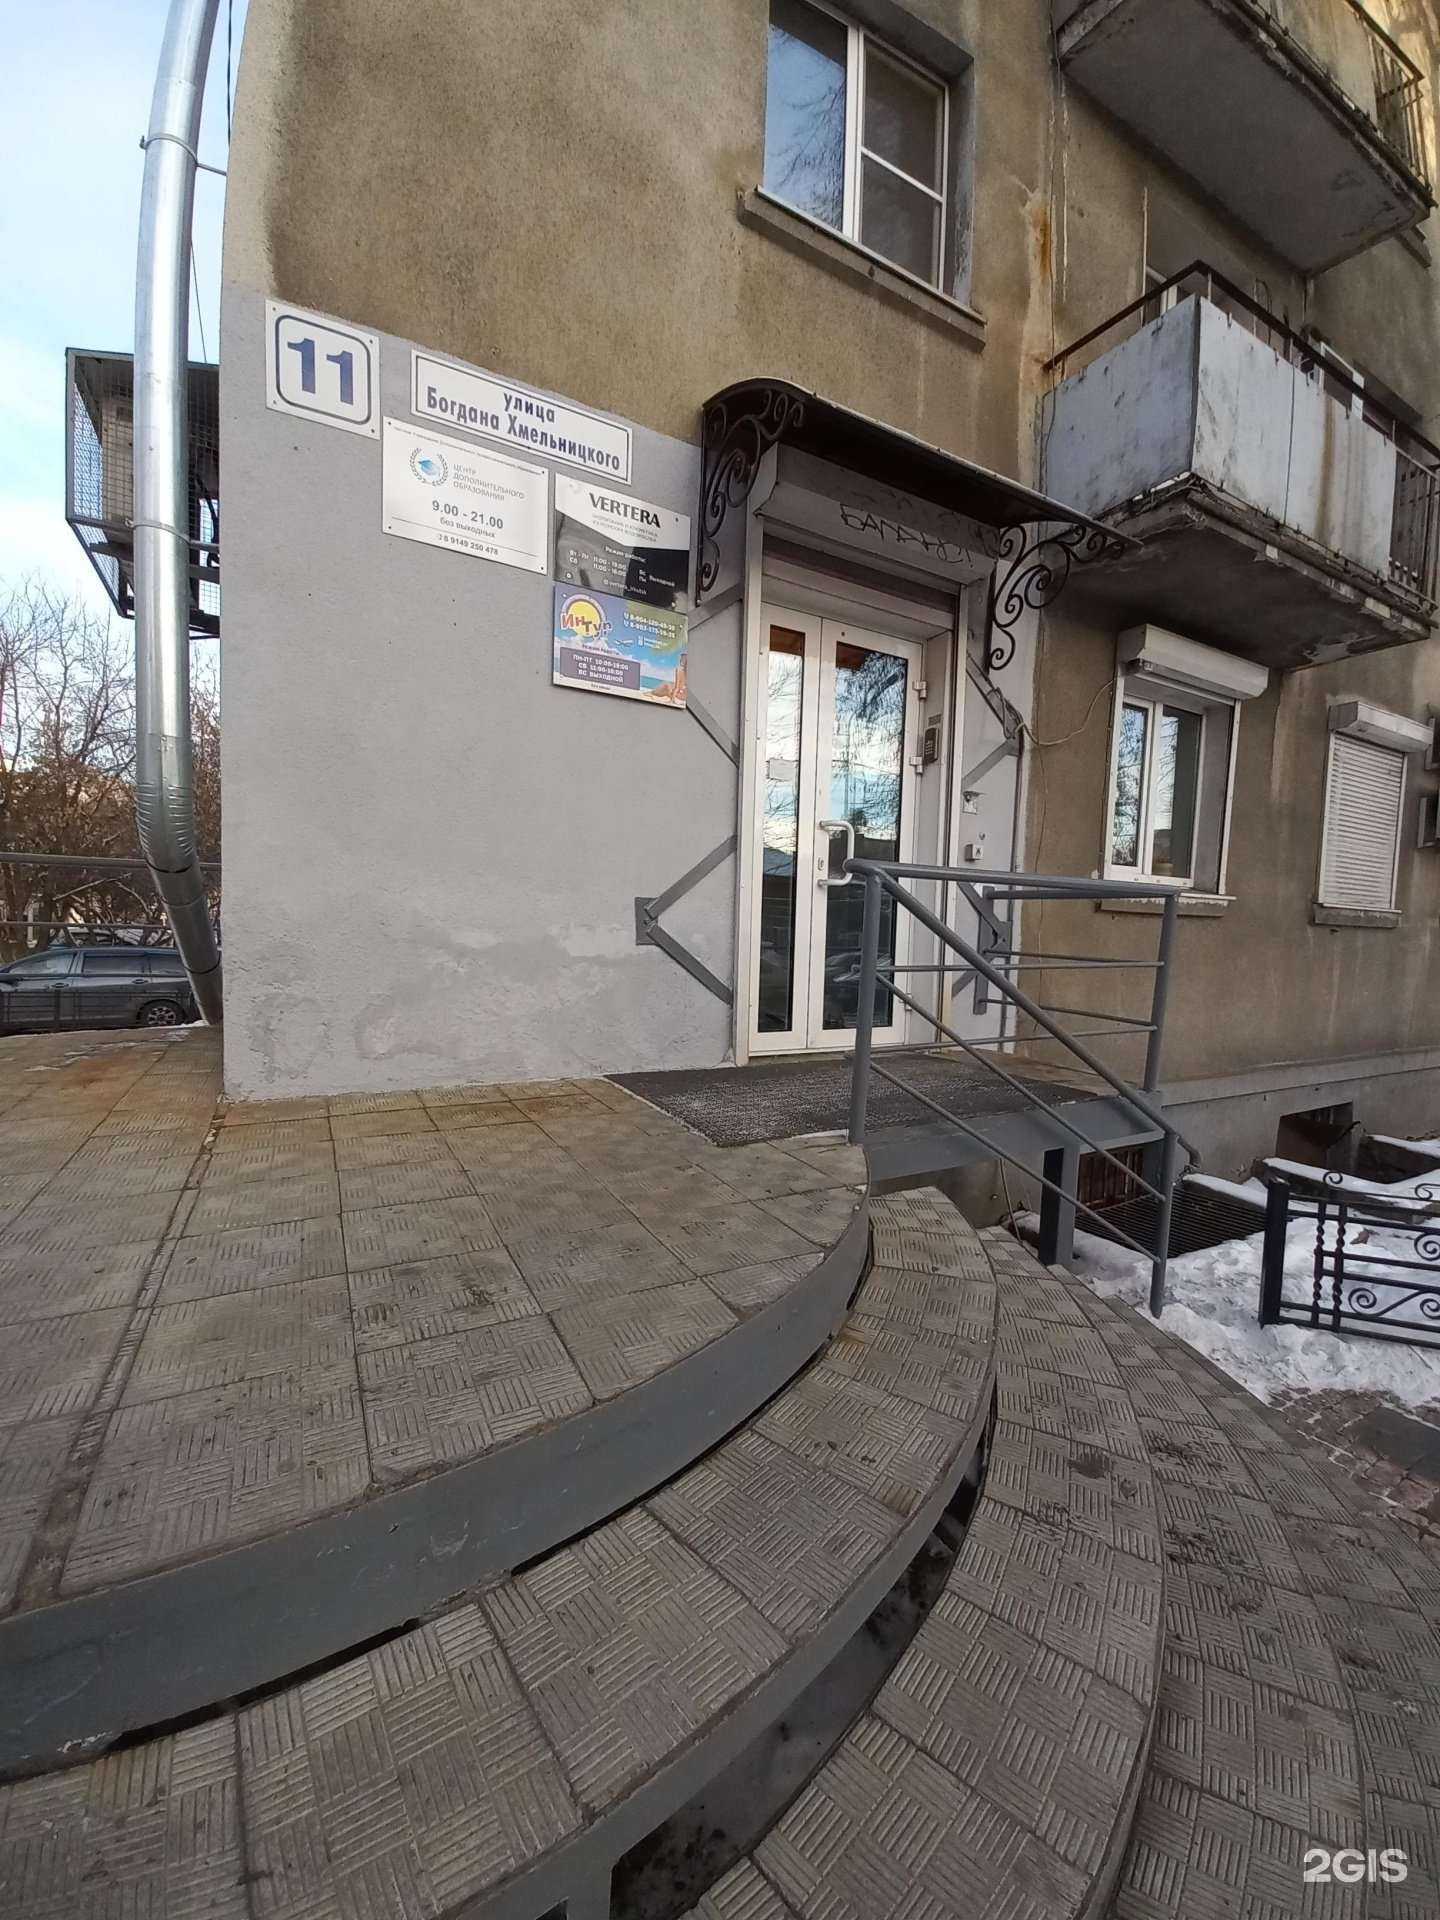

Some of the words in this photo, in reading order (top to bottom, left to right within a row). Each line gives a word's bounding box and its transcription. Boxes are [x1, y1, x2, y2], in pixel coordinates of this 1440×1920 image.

[287, 338, 353, 405] 11
[503, 392, 556, 423] улица
[426, 386, 500, 430] Богдана
[507, 413, 620, 471] Хмельницкого
[452, 472, 525, 500] ДОПОЛНИТЕЛЬНОГО
[453, 481, 505, 501] ОБРАЗОВАНИЯ
[432, 500, 459, 517] 9.00
[470, 511, 504, 530] 21.00
[589, 492, 661, 528] VERTERA
[440, 517, 454, 528] без
[456, 522, 496, 538] выходных
[590, 671, 623, 683] ВЫХОДНОЙ
